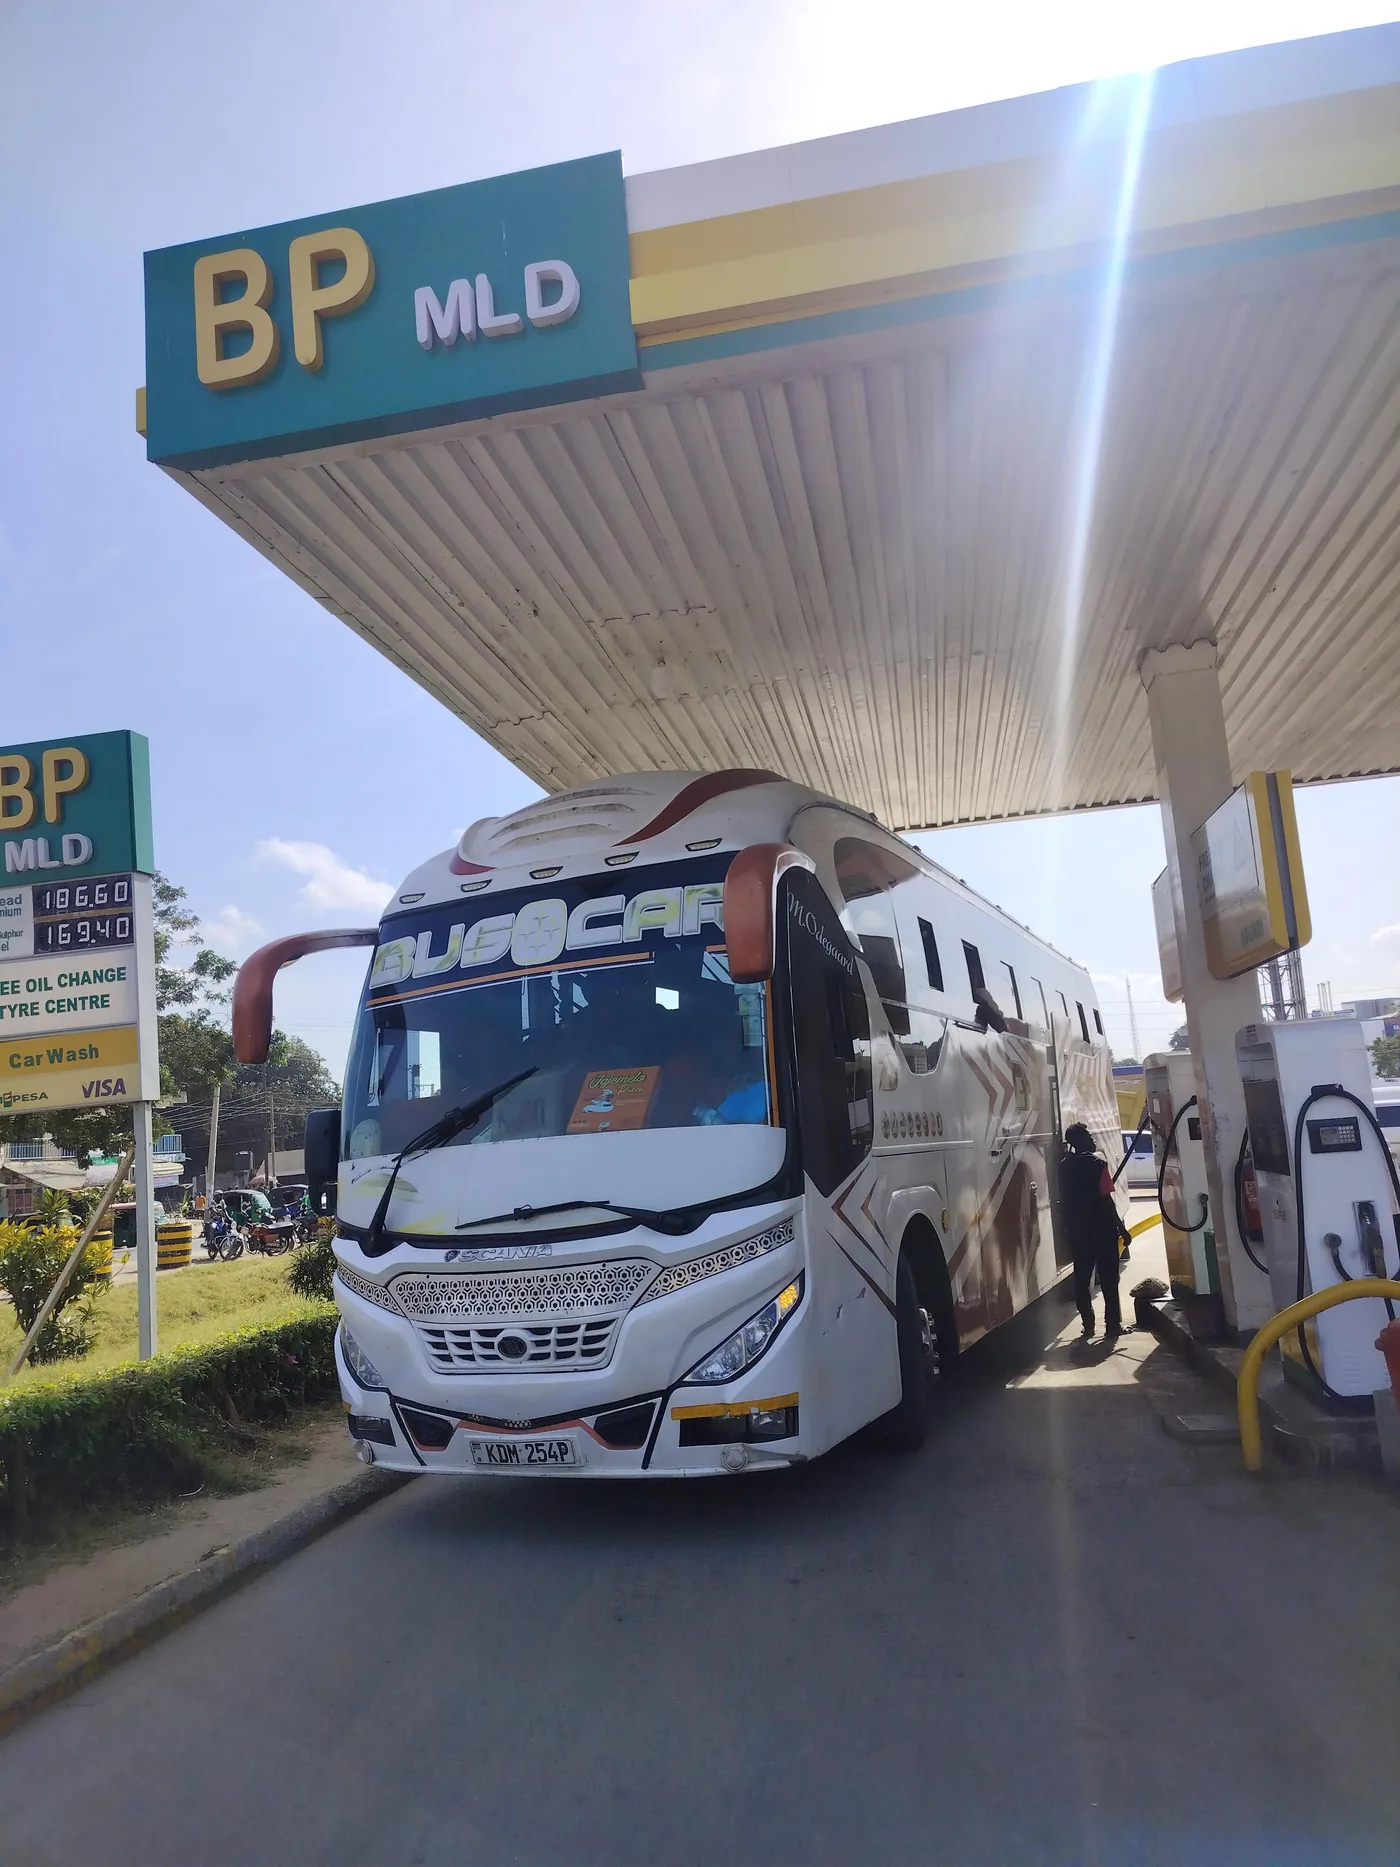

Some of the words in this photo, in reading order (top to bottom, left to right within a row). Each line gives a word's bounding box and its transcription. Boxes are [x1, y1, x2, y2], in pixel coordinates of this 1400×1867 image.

[193, 227, 375, 391] BP
[414, 259, 581, 351] MLD
[0, 747, 89, 831] BP
[4, 833, 93, 873] MLD
[46, 881, 128, 909] 186.60
[48, 917, 130, 945] 169.40
[26, 977, 53, 993] OIL
[57, 966, 127, 988] CHANGE
[0, 1002, 40, 1019] TYRE
[45, 994, 110, 1014] CENTRE
[9, 1053, 43, 1069] Car
[46, 1044, 99, 1064] Wash
[82, 1078, 127, 1099] VISA
[458, 1244, 553, 1263] SCANIA
[485, 1443, 521, 1464] KDM
[524, 1441, 569, 1464] 254P
